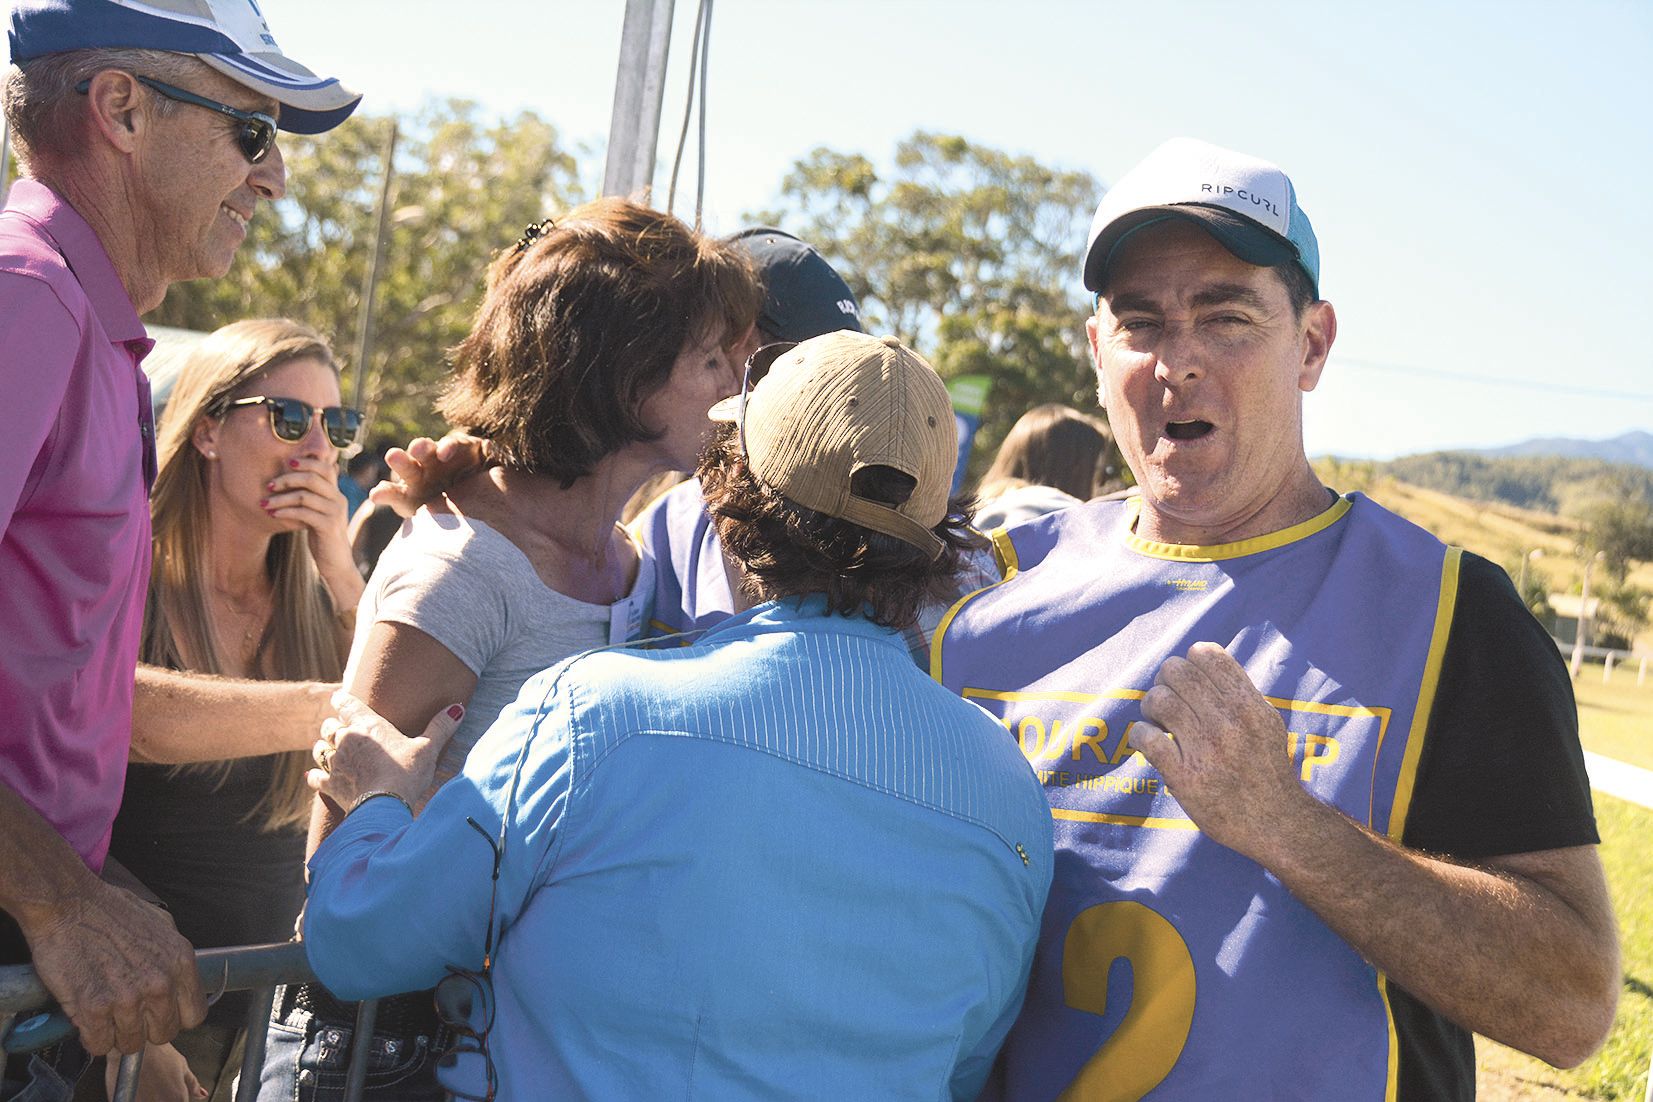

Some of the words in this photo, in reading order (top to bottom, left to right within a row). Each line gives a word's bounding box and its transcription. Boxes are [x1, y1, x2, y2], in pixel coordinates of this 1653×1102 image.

[1000, 715, 1173, 768] OURA
[1075, 772, 1159, 796] HIPPIQUE
[1056, 900, 1196, 1102] 2
